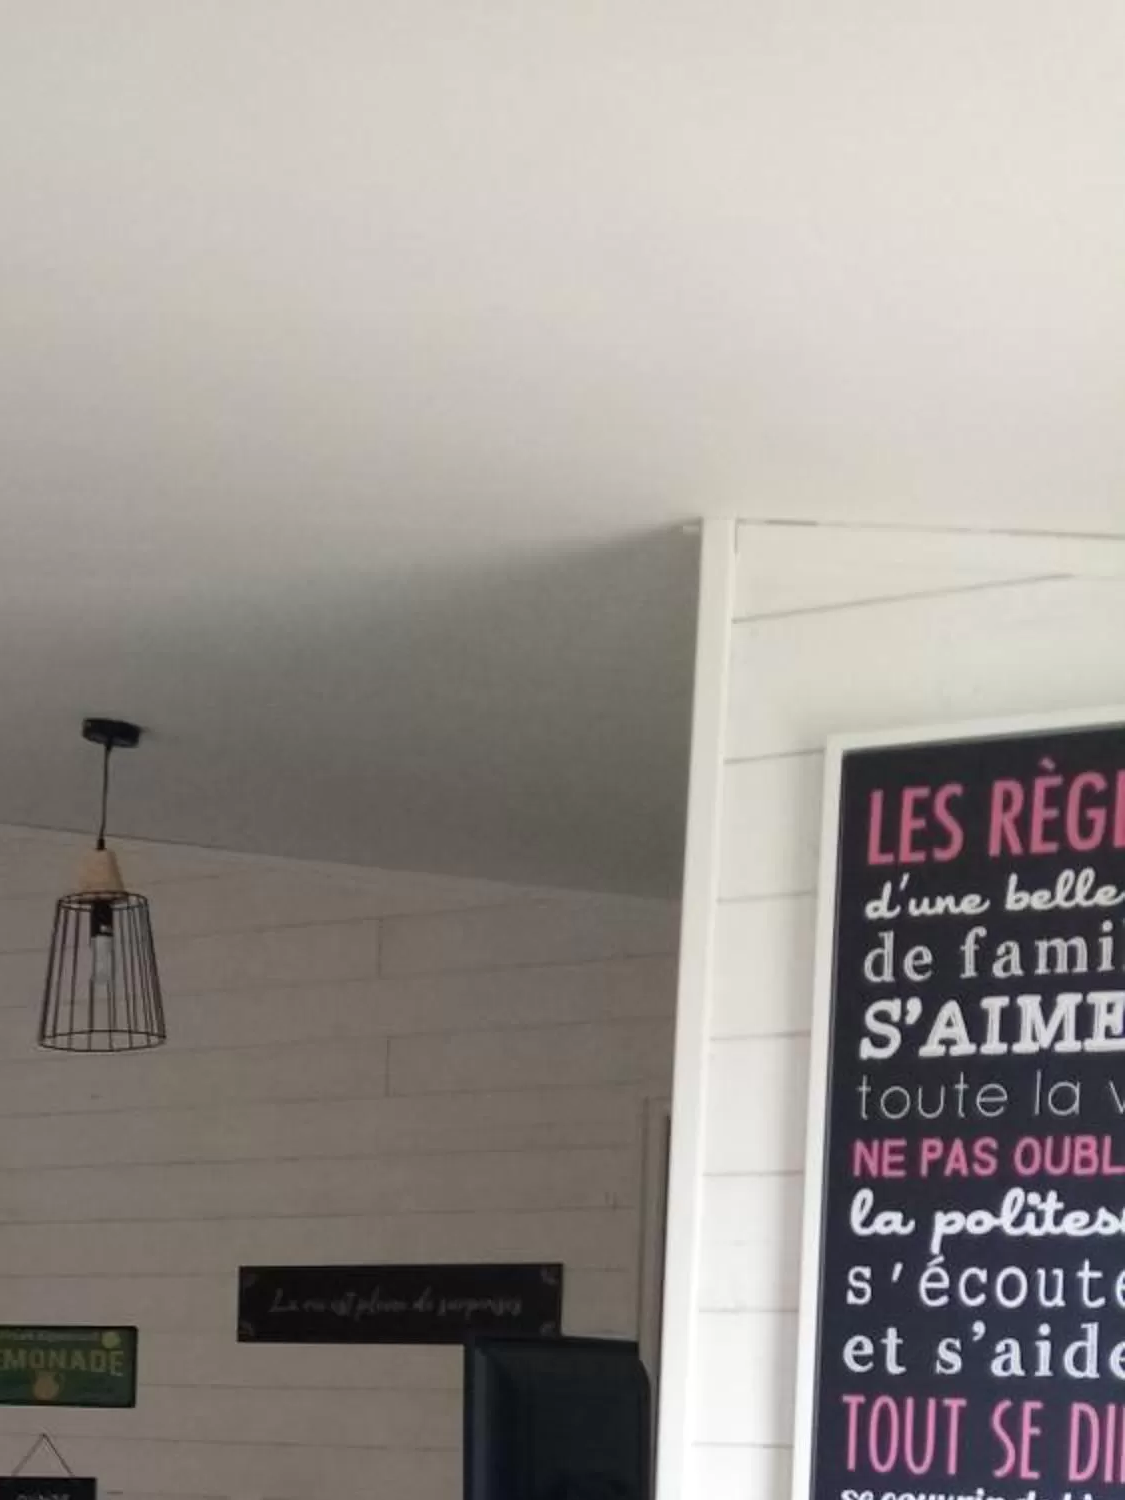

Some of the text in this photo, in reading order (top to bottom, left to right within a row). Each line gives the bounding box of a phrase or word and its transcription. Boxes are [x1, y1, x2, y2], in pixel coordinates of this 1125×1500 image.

[867, 782, 965, 865] LES
[864, 866, 1125, 920] d'une belle
[863, 920, 1125, 983] de fami
[859, 991, 1125, 1060] S'AIME
[855, 1070, 1008, 1120] toute
[1035, 1069, 1081, 1116] la
[852, 1134, 1125, 1178] NE PAS OUBL
[850, 1186, 1125, 1255] la polites
[842, 1326, 907, 1375] et
[842, 1394, 1125, 1484] TOUT SE DI
